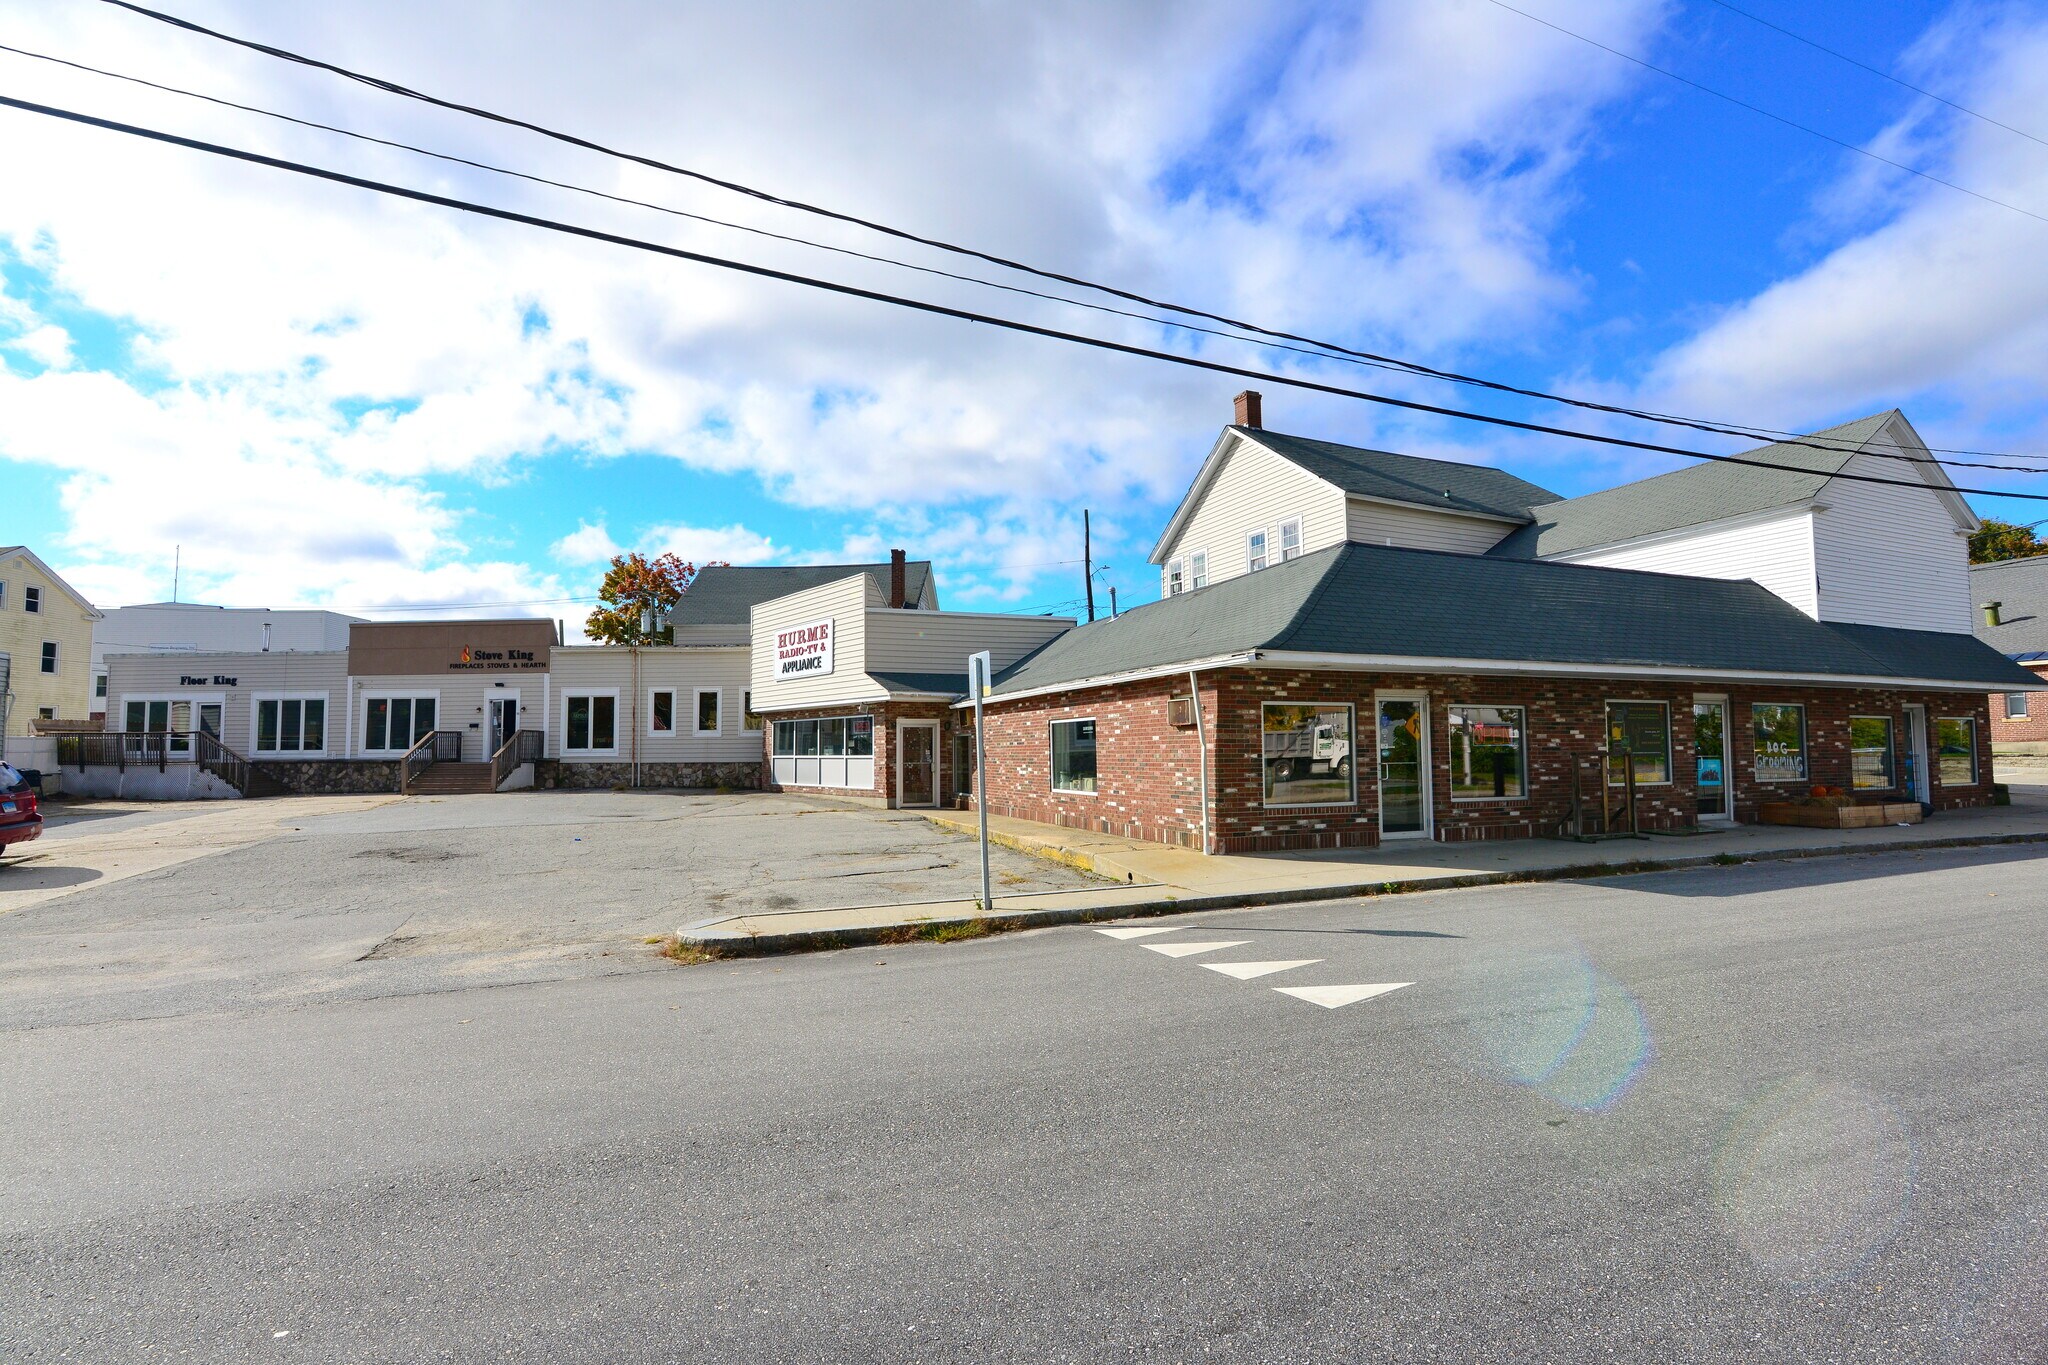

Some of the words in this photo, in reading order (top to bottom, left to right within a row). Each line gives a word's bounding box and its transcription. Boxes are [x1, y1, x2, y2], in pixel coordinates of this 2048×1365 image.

[778, 624, 828, 649] HURME
[474, 650, 503, 660] Stove
[508, 650, 534, 661] King
[779, 643, 819, 659] RADIO-TV
[820, 641, 827, 652] &
[782, 656, 822, 674] APPLIANCE
[180, 676, 208, 686] Floor
[213, 675, 238, 687] King
[1474, 727, 1511, 745] OPEN
[1766, 740, 1788, 755] DOG
